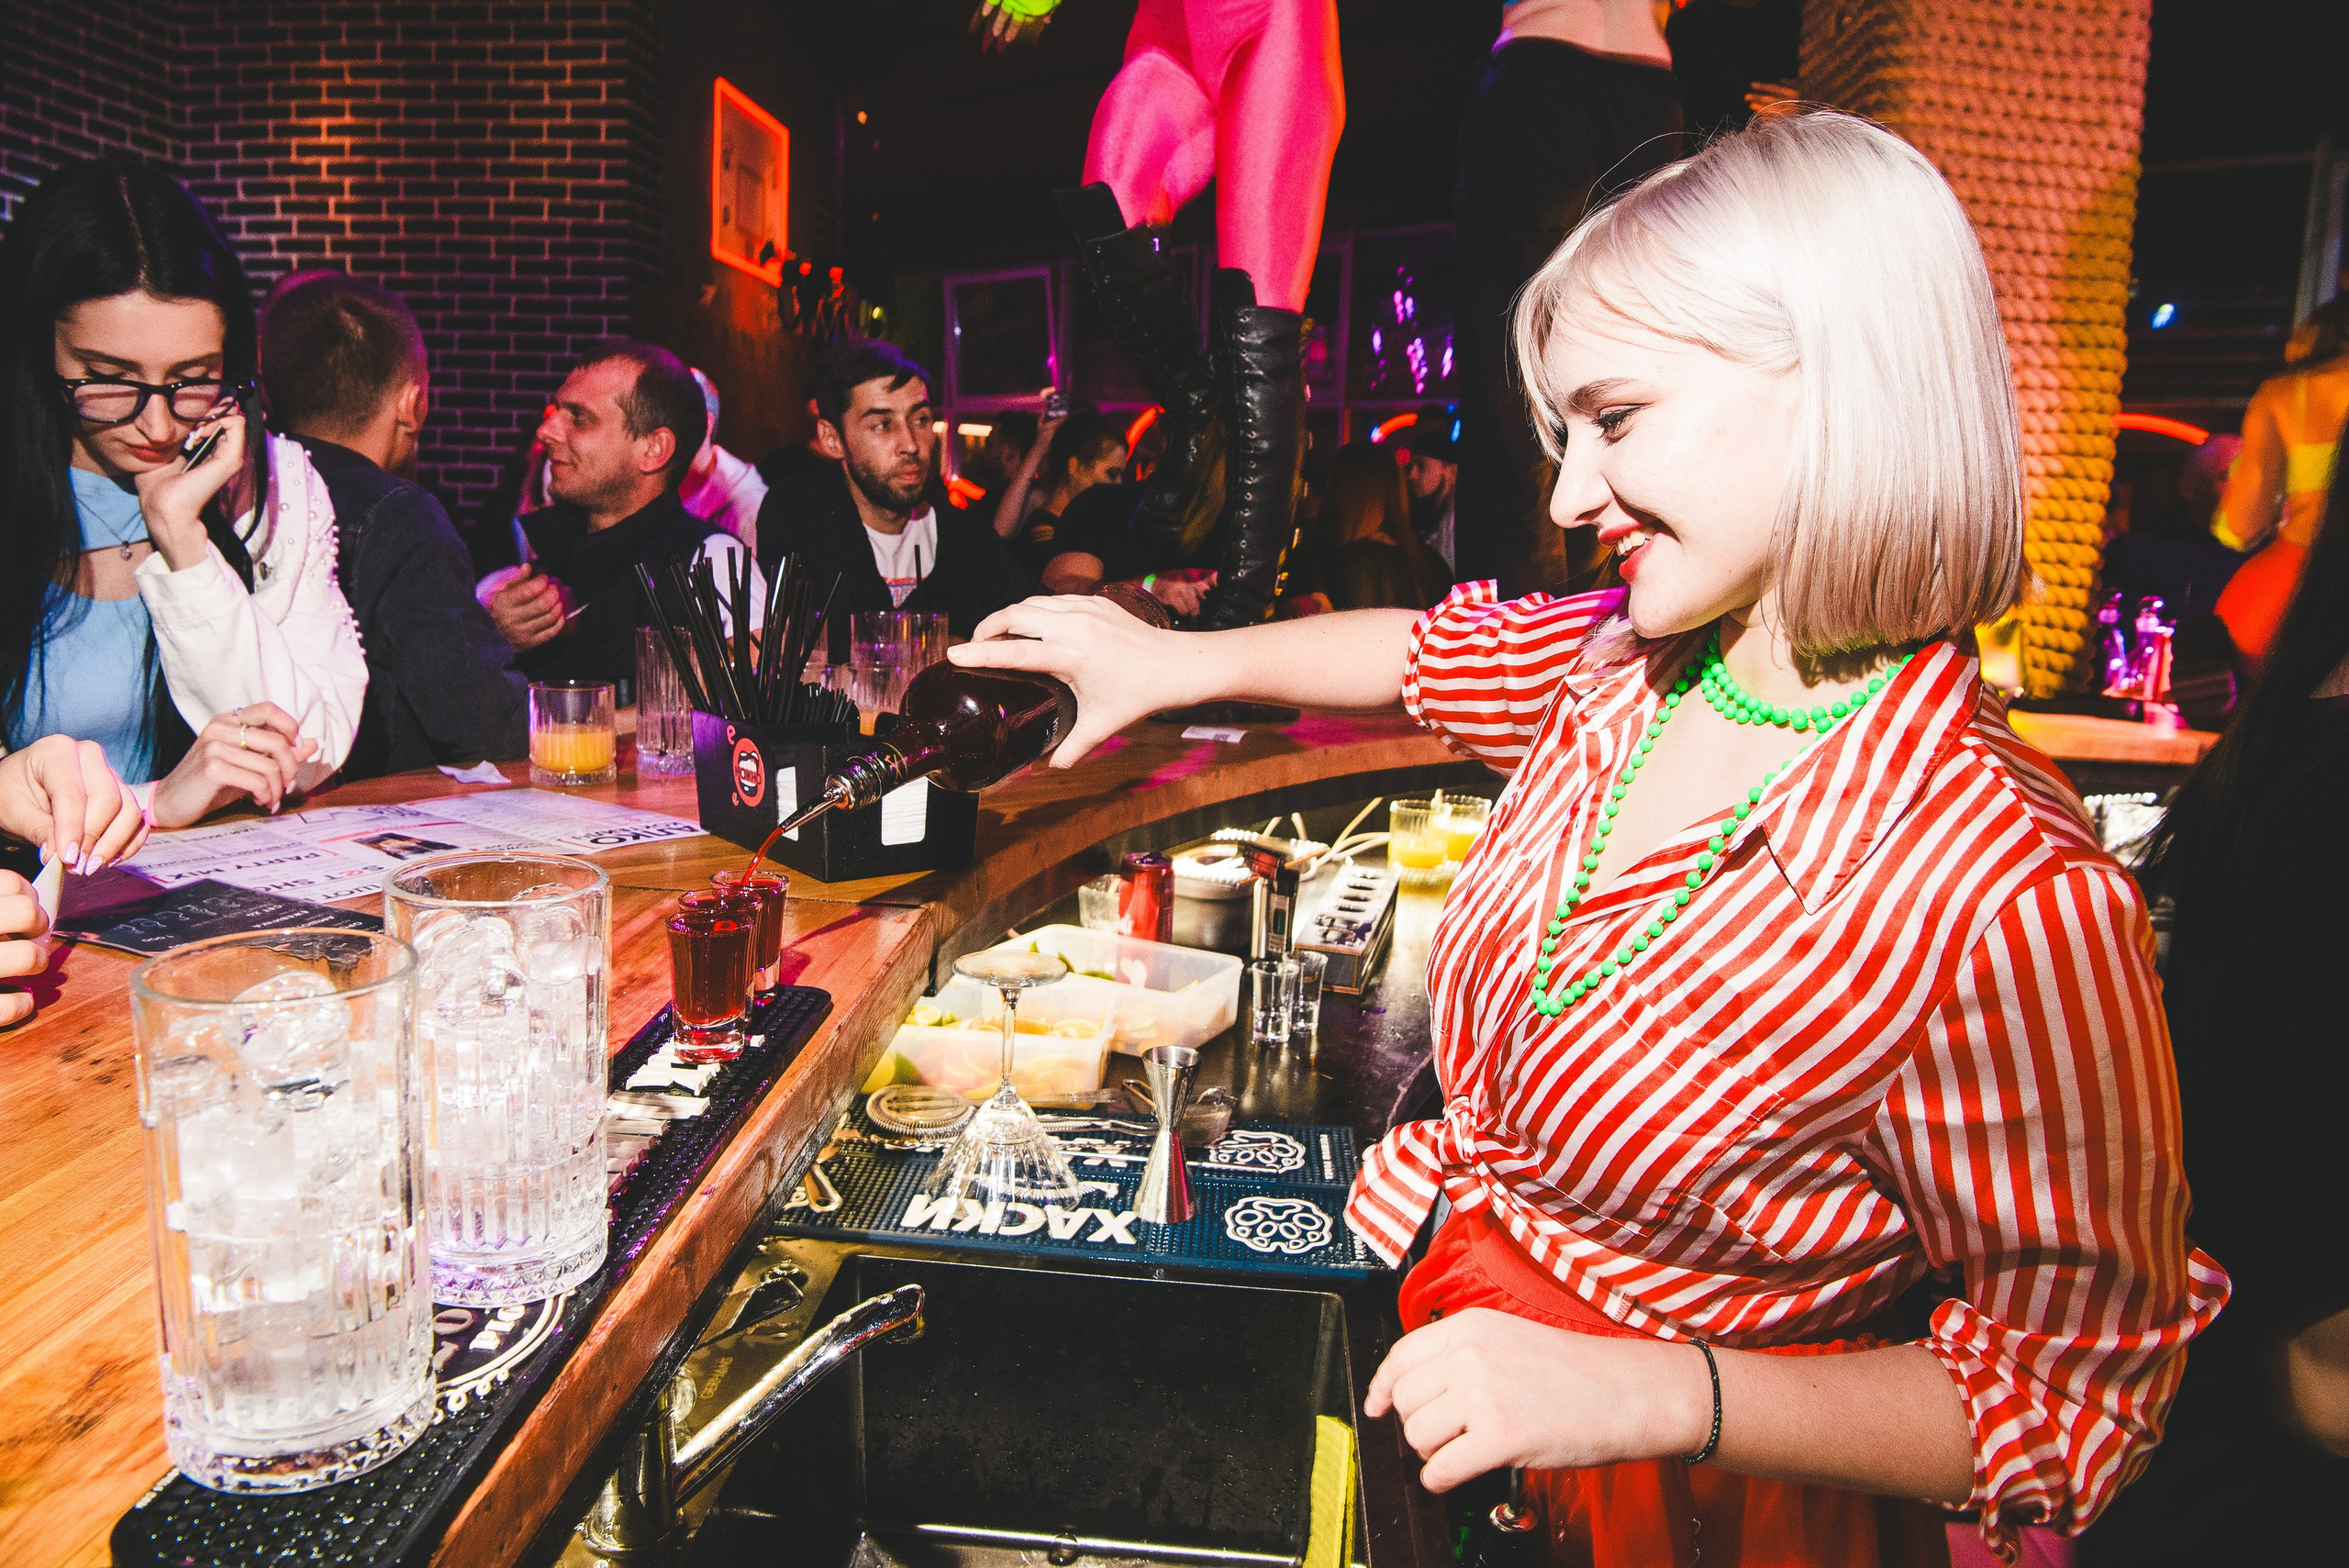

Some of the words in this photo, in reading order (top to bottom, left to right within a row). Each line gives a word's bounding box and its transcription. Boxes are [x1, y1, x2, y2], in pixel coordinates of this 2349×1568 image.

[590, 825, 698, 844] АЛКО
[235, 852, 321, 870] PARTY
[167, 866, 224, 880] MIX
[900, 1193, 1138, 1245] ХАСКИ
